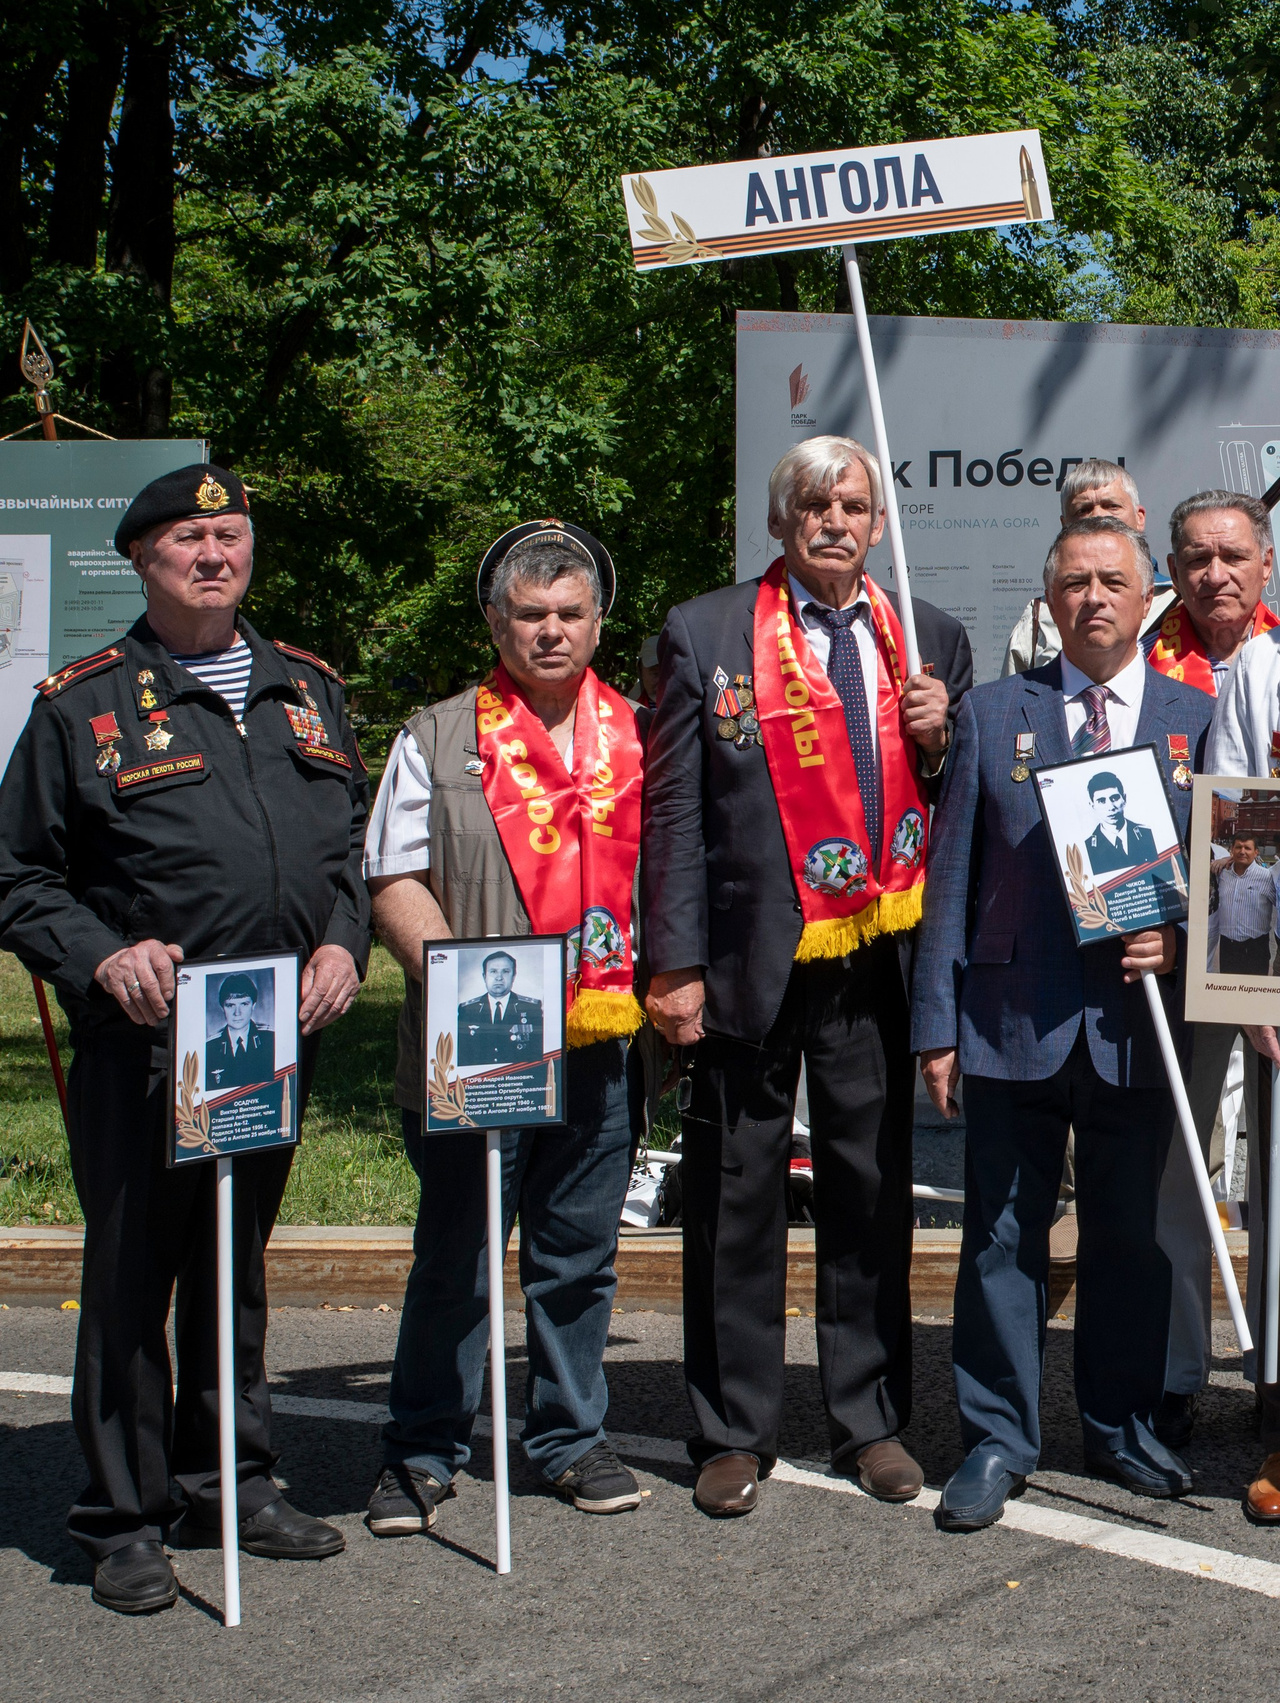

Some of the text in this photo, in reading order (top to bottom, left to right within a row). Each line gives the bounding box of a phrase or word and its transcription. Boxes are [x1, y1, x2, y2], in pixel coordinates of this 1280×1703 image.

[744, 153, 943, 227] АНГОЛА
[901, 504, 934, 514] ГОРЕ
[910, 519, 998, 530] POKLONNAYA
[1003, 518, 1040, 528] GORA
[122, 758, 201, 784] МОРСКАЯ ПЕХОТА РОССИИ
[500, 738, 562, 855] Союз
[1205, 982, 1237, 992] Михаил
[220, 1108, 238, 1116] Виктор
